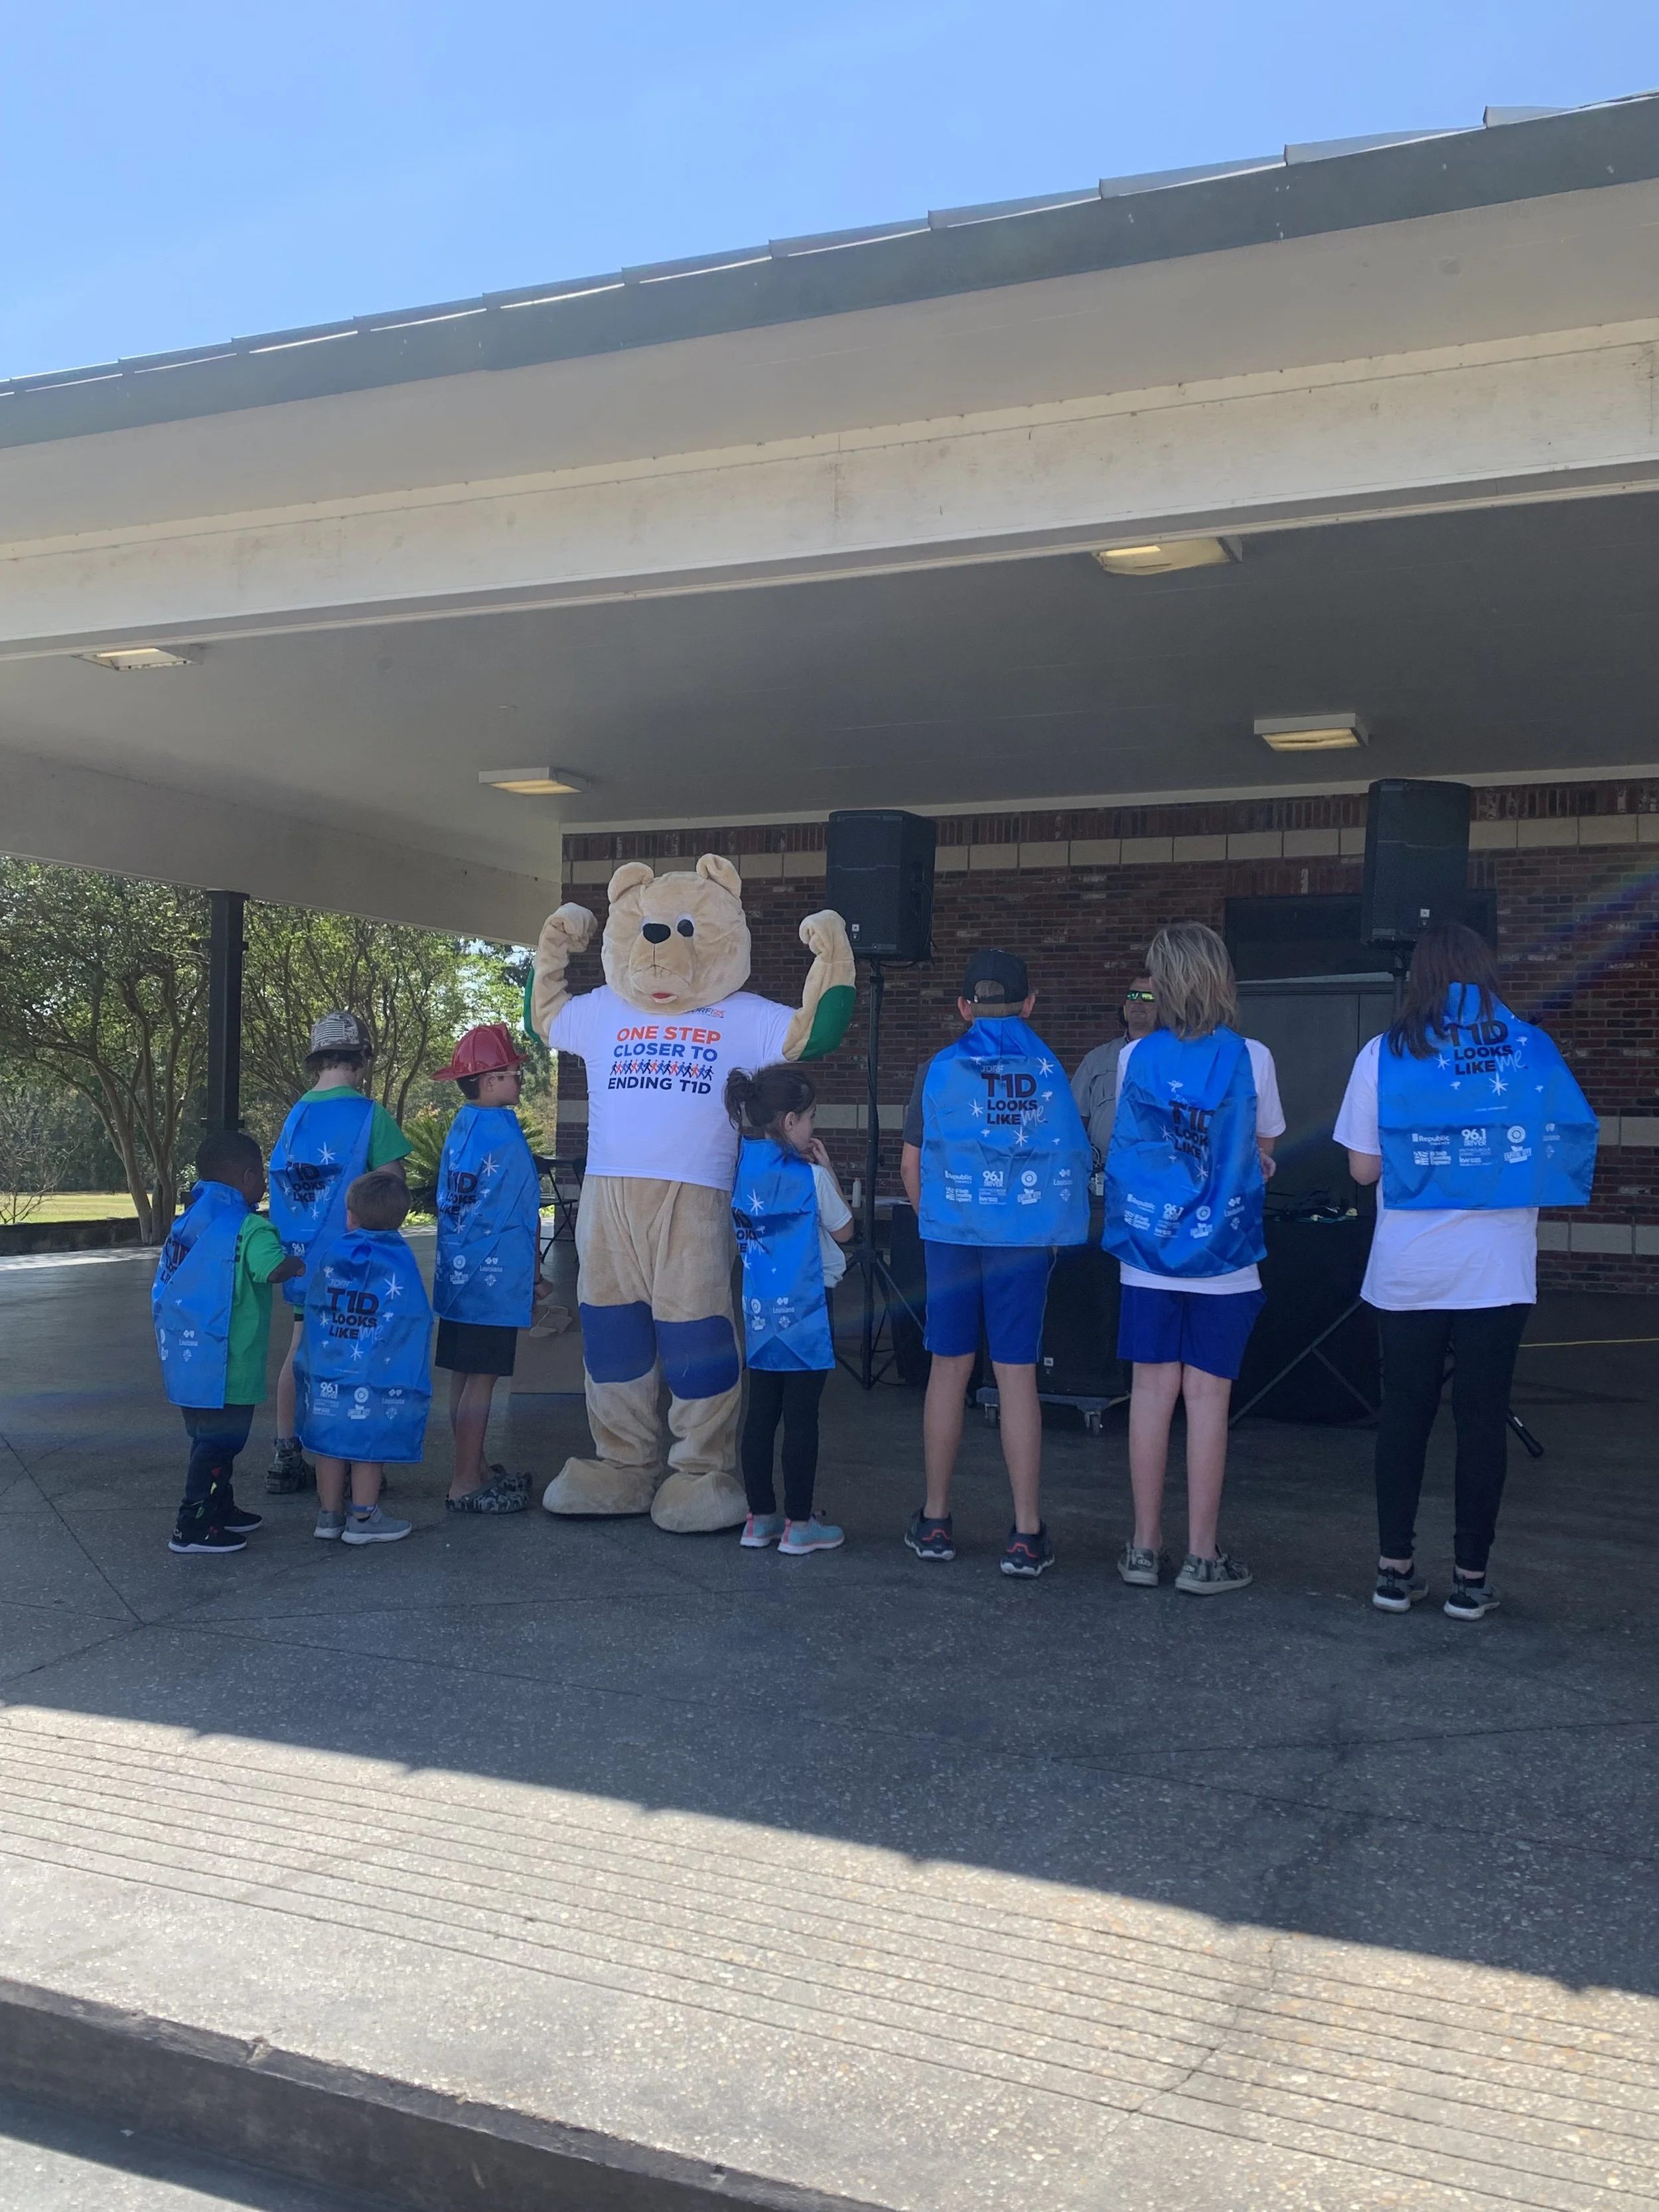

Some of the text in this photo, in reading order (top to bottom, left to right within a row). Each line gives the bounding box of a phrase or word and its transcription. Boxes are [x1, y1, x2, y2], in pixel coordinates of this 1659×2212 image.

[616, 1025, 721, 1045] ONE STEP
[614, 1043, 718, 1062] CLOSER TO
[1454, 1045, 1513, 1061] LOOKS
[1455, 1060, 1496, 1075] LIKE
[608, 1076, 711, 1094] ENDING T1D
[981, 1072, 1037, 1098] T1D
[987, 1099, 1038, 1111] LOOKS
[987, 1113, 1021, 1124] LIKE
[1175, 1126, 1208, 1147] LOOK
[326, 1288, 380, 1315] T1D
[332, 1313, 378, 1328] LOOKS
[329, 1325, 359, 1340] LIKE
